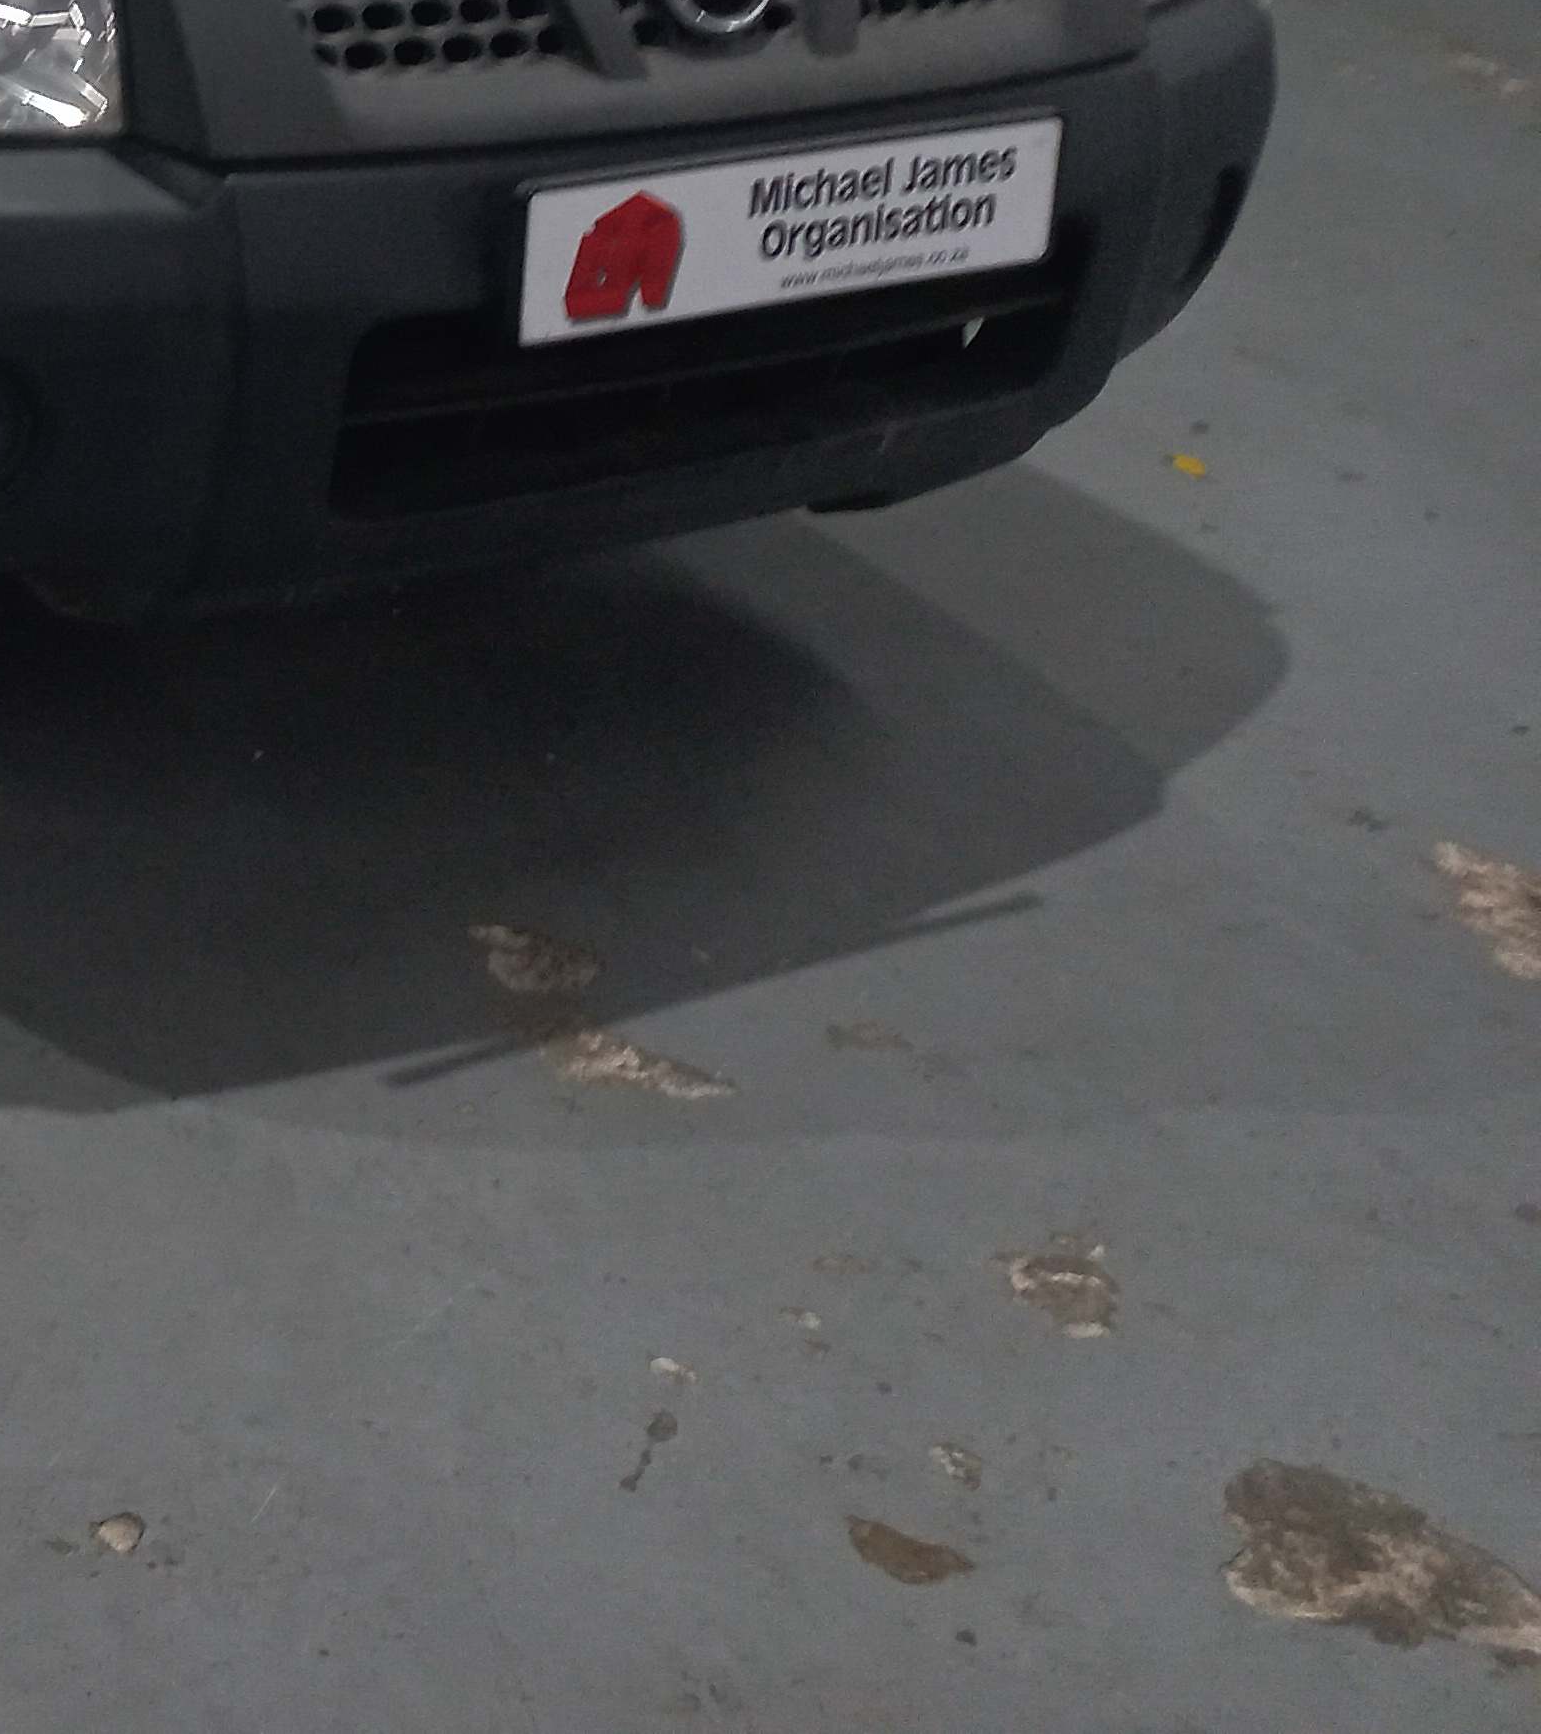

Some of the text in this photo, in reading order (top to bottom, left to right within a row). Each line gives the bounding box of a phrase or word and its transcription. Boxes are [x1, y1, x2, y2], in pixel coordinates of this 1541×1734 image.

[748, 145, 1018, 218] Michael James
[760, 192, 997, 262] Organisation
